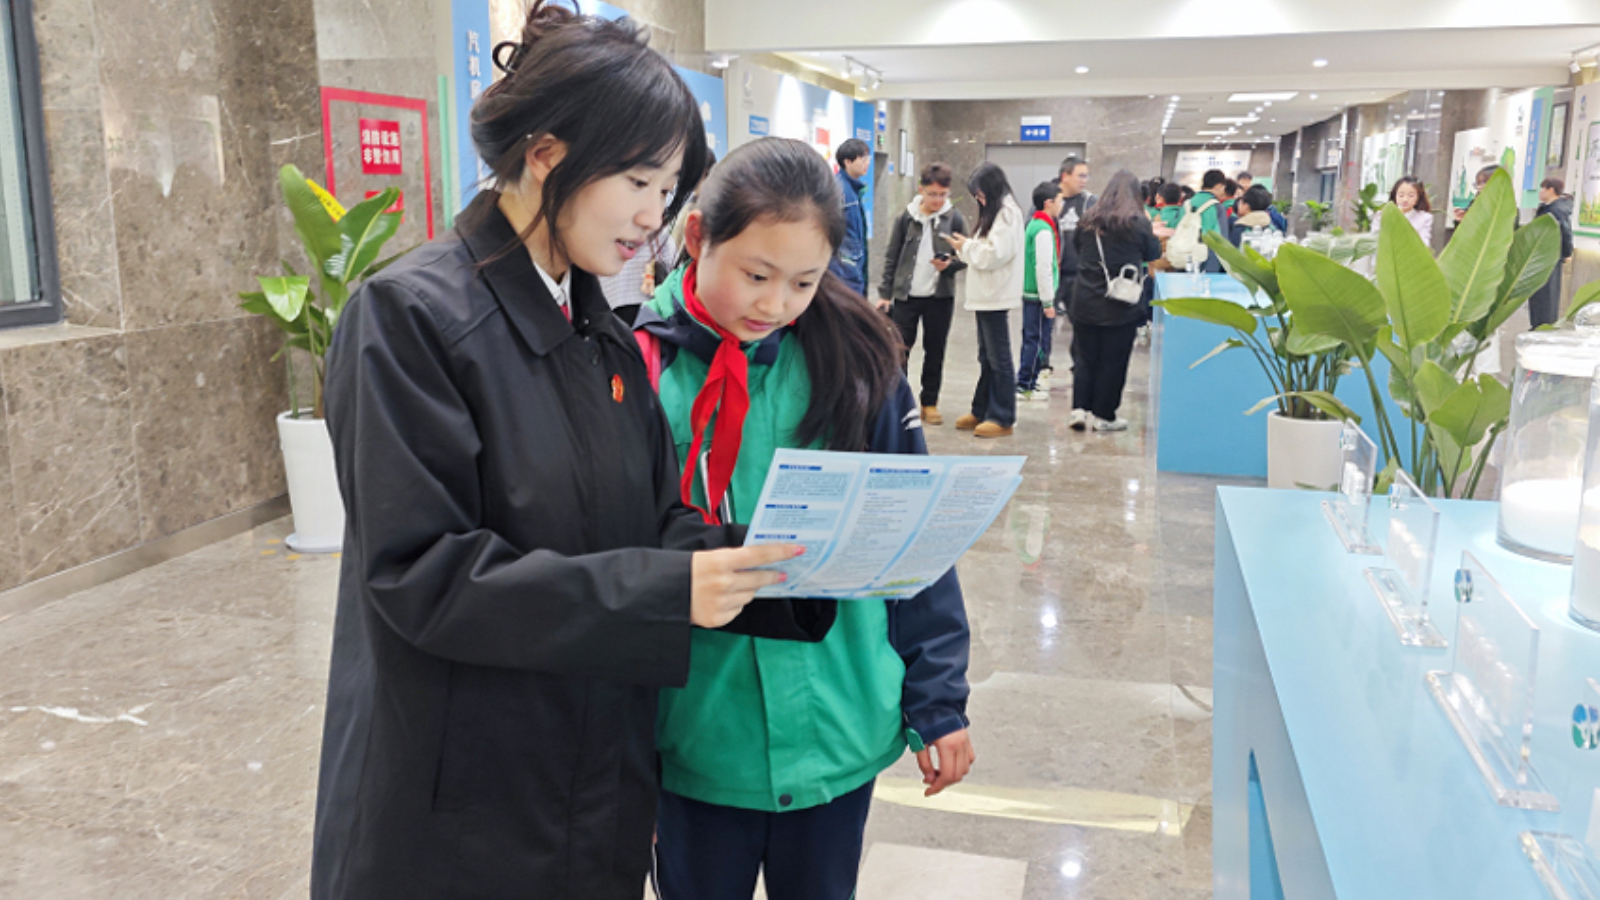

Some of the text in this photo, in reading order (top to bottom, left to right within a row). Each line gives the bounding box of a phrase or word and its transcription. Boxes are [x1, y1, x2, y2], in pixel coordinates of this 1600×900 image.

[362, 129, 400, 146] 消防设施
[363, 148, 400, 165] 非警勿用
